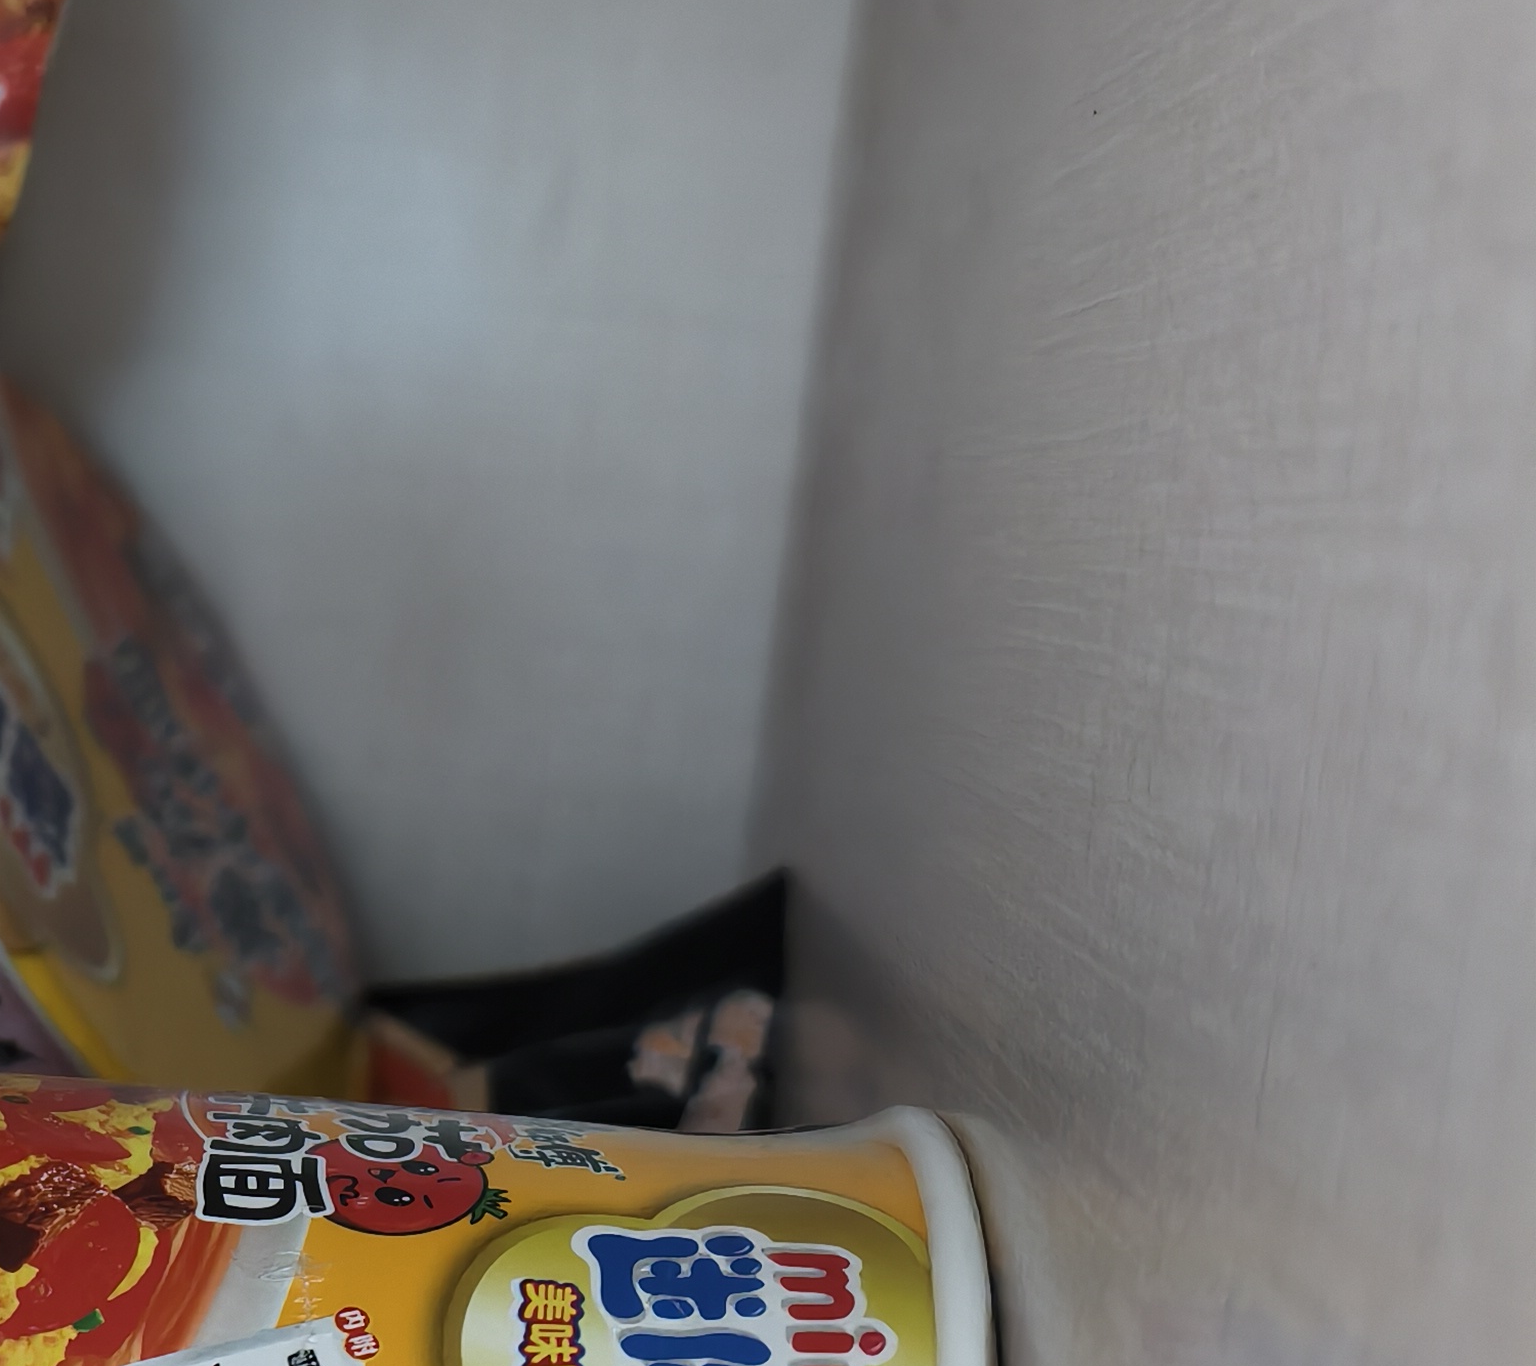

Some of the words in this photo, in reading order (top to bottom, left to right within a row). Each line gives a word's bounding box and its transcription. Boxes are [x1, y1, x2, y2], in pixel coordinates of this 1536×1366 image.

[202, 1093, 327, 1222] 牛肉面
[341, 1108, 484, 1162] 茄
[336, 1308, 378, 1357] 内附
